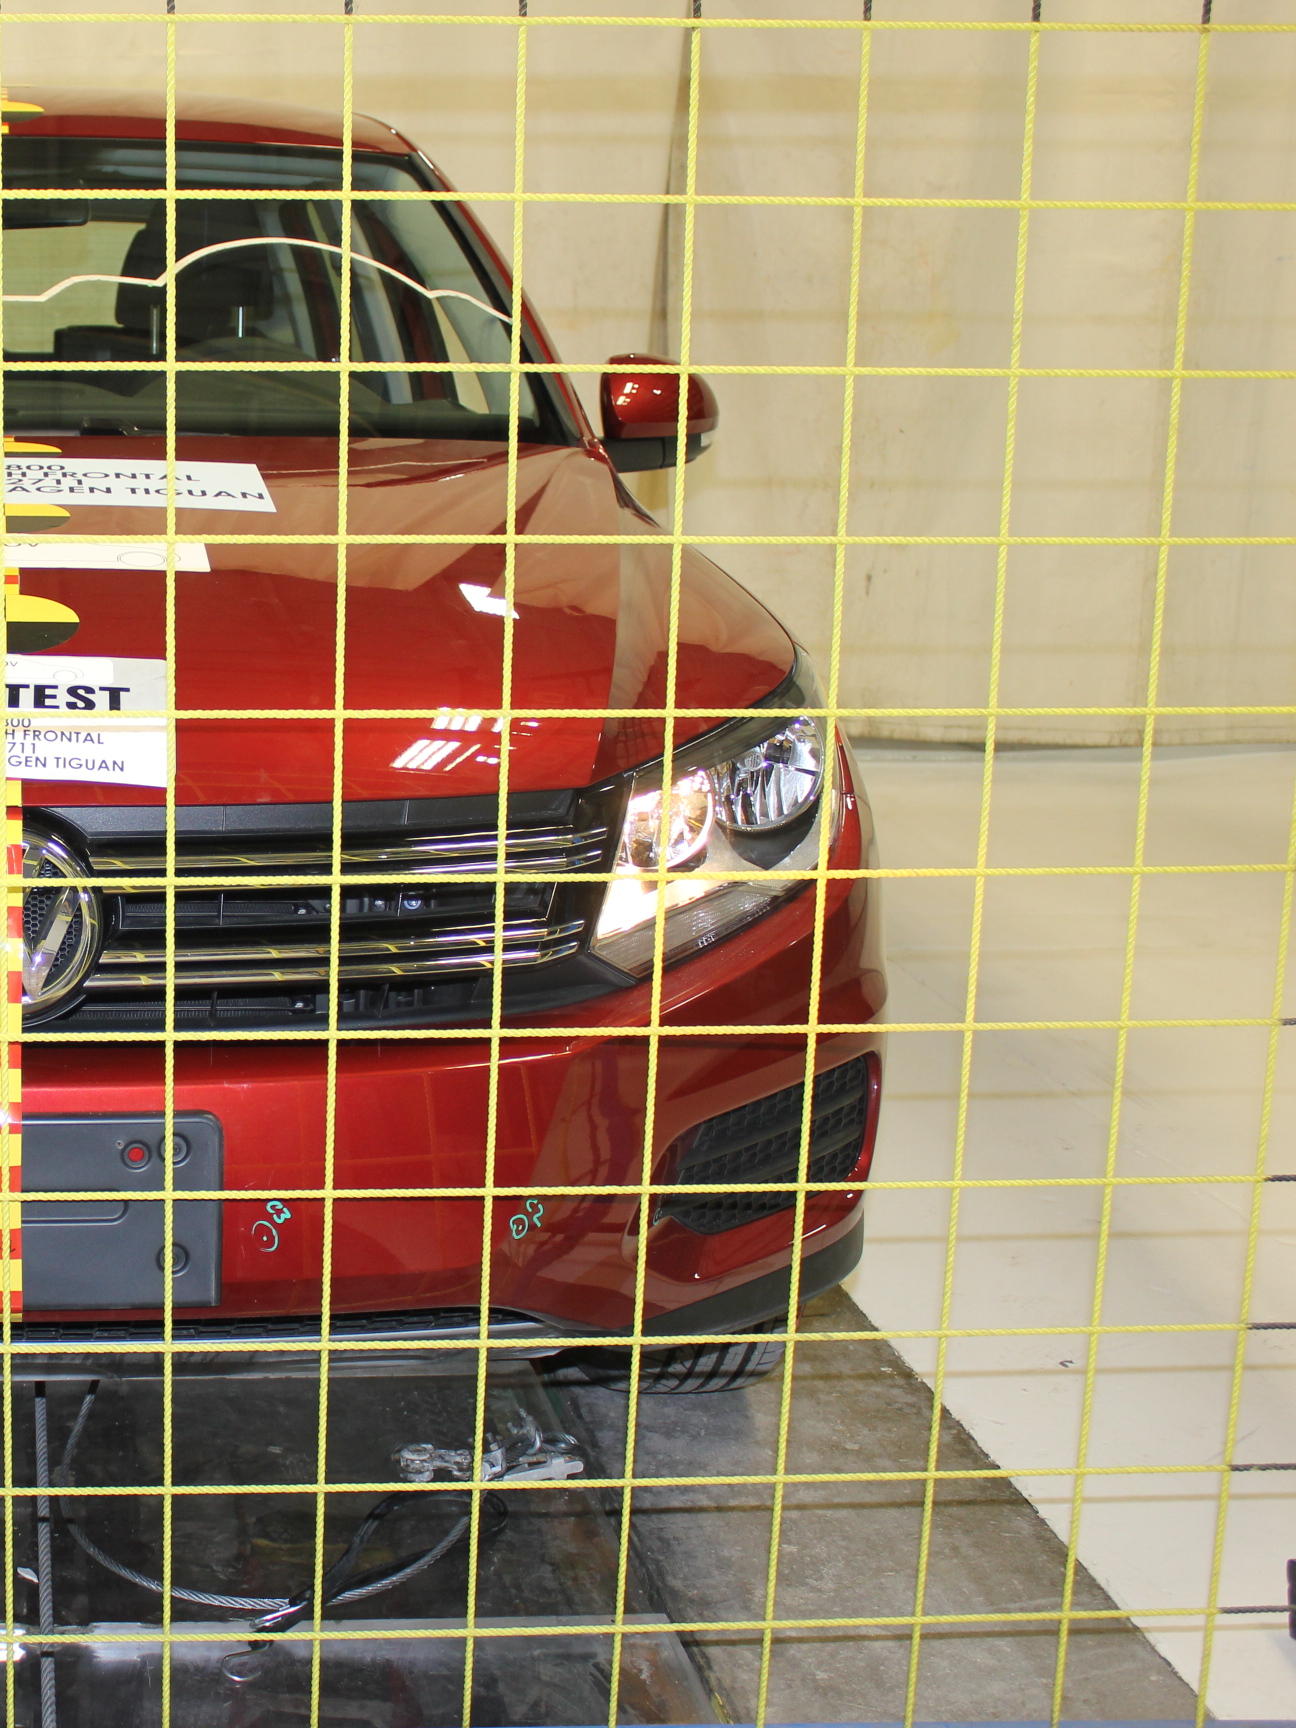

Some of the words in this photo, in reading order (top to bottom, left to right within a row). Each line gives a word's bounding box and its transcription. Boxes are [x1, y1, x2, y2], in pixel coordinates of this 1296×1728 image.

[42, 471, 201, 482] FRONTAL
[124, 486, 266, 500] TIGUAN
[23, 729, 105, 745] FRONTAL
[53, 756, 125, 772] TIGUAN
